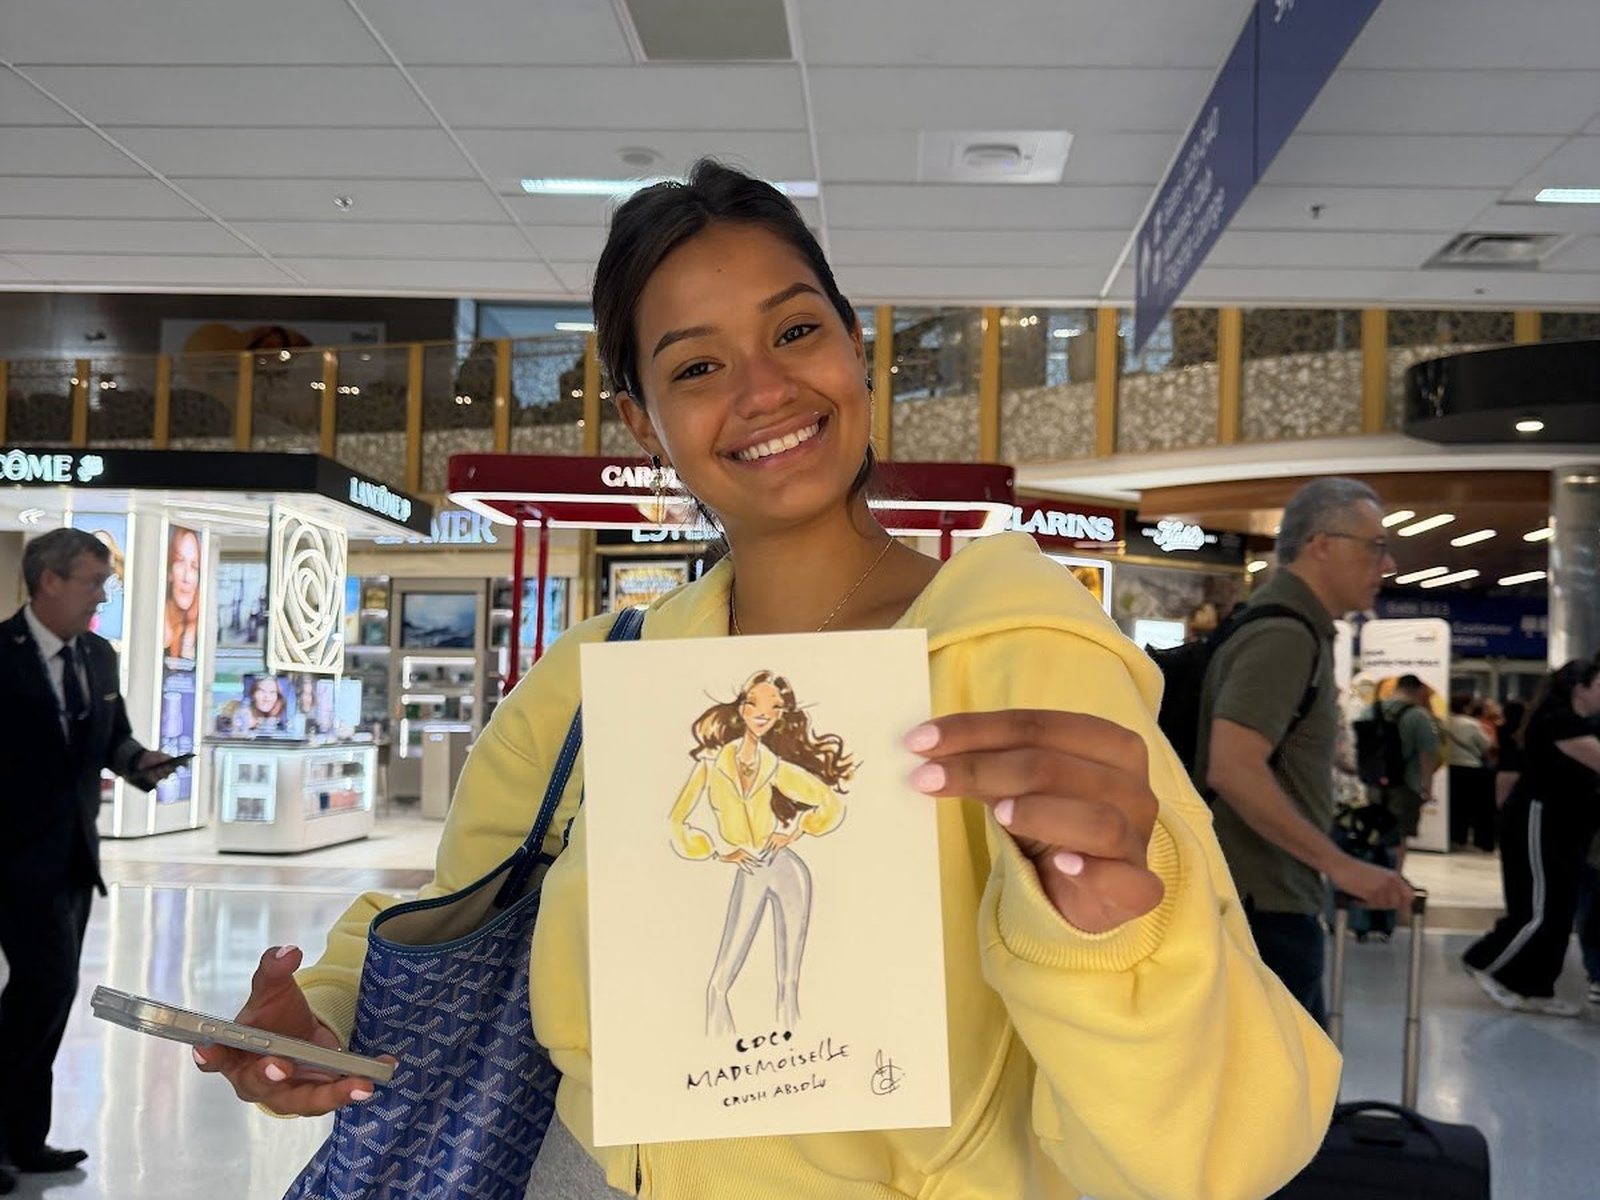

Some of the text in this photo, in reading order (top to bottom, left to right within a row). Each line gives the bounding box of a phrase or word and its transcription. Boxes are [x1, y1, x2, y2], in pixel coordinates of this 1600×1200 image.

[1004, 506, 1115, 542] LARINS
[723, 1073, 827, 1107] CRUSH ABSOLU
